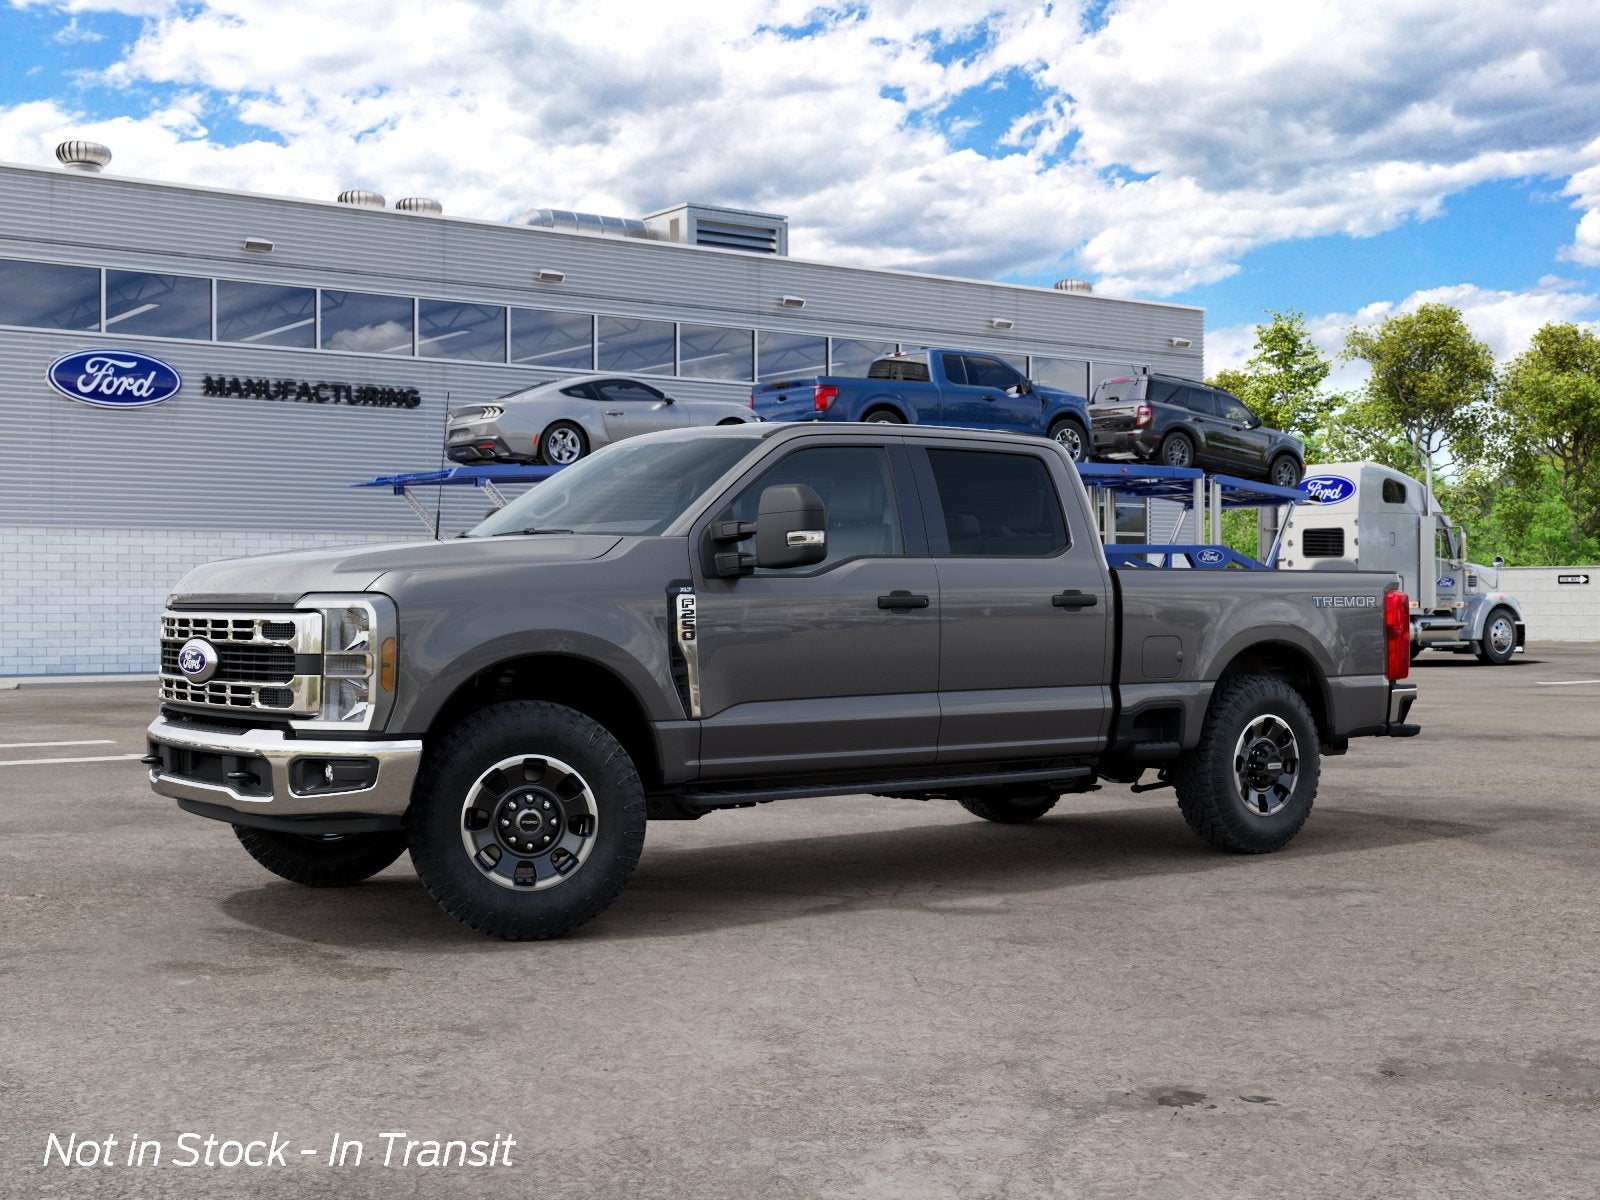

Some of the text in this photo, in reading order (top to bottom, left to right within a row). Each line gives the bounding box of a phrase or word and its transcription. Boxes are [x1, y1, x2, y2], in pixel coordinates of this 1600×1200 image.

[76, 356, 157, 398] Ford
[203, 373, 422, 409] MANUFACTURING
[1306, 479, 1343, 500] Ford
[1201, 550, 1220, 561] Ford
[1312, 595, 1377, 608] TREMOR
[681, 598, 696, 641] F250
[183, 649, 202, 670] Ford
